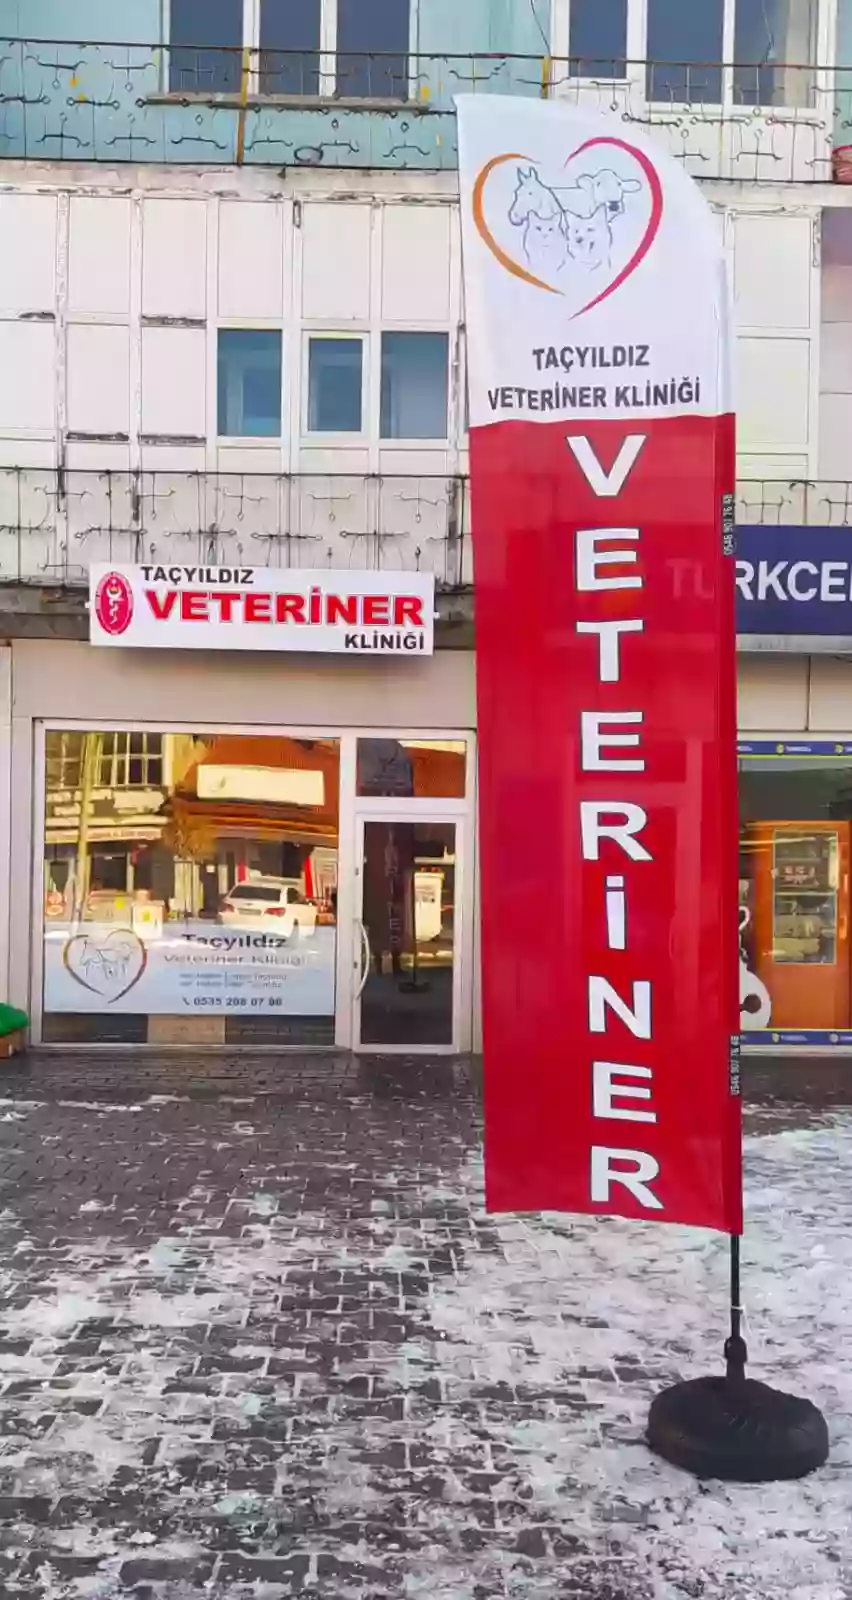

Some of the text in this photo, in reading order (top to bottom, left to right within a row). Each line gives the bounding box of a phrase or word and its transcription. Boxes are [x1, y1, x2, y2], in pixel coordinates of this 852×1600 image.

[532, 344, 651, 373] TAÇYILDIZ
[487, 376, 701, 411] VETERİNER KLİNİĞİ
[140, 566, 254, 585] TAÇYILDIZ
[145, 586, 425, 627] VETERİNER
[344, 630, 425, 650] KLİNİĞİ
